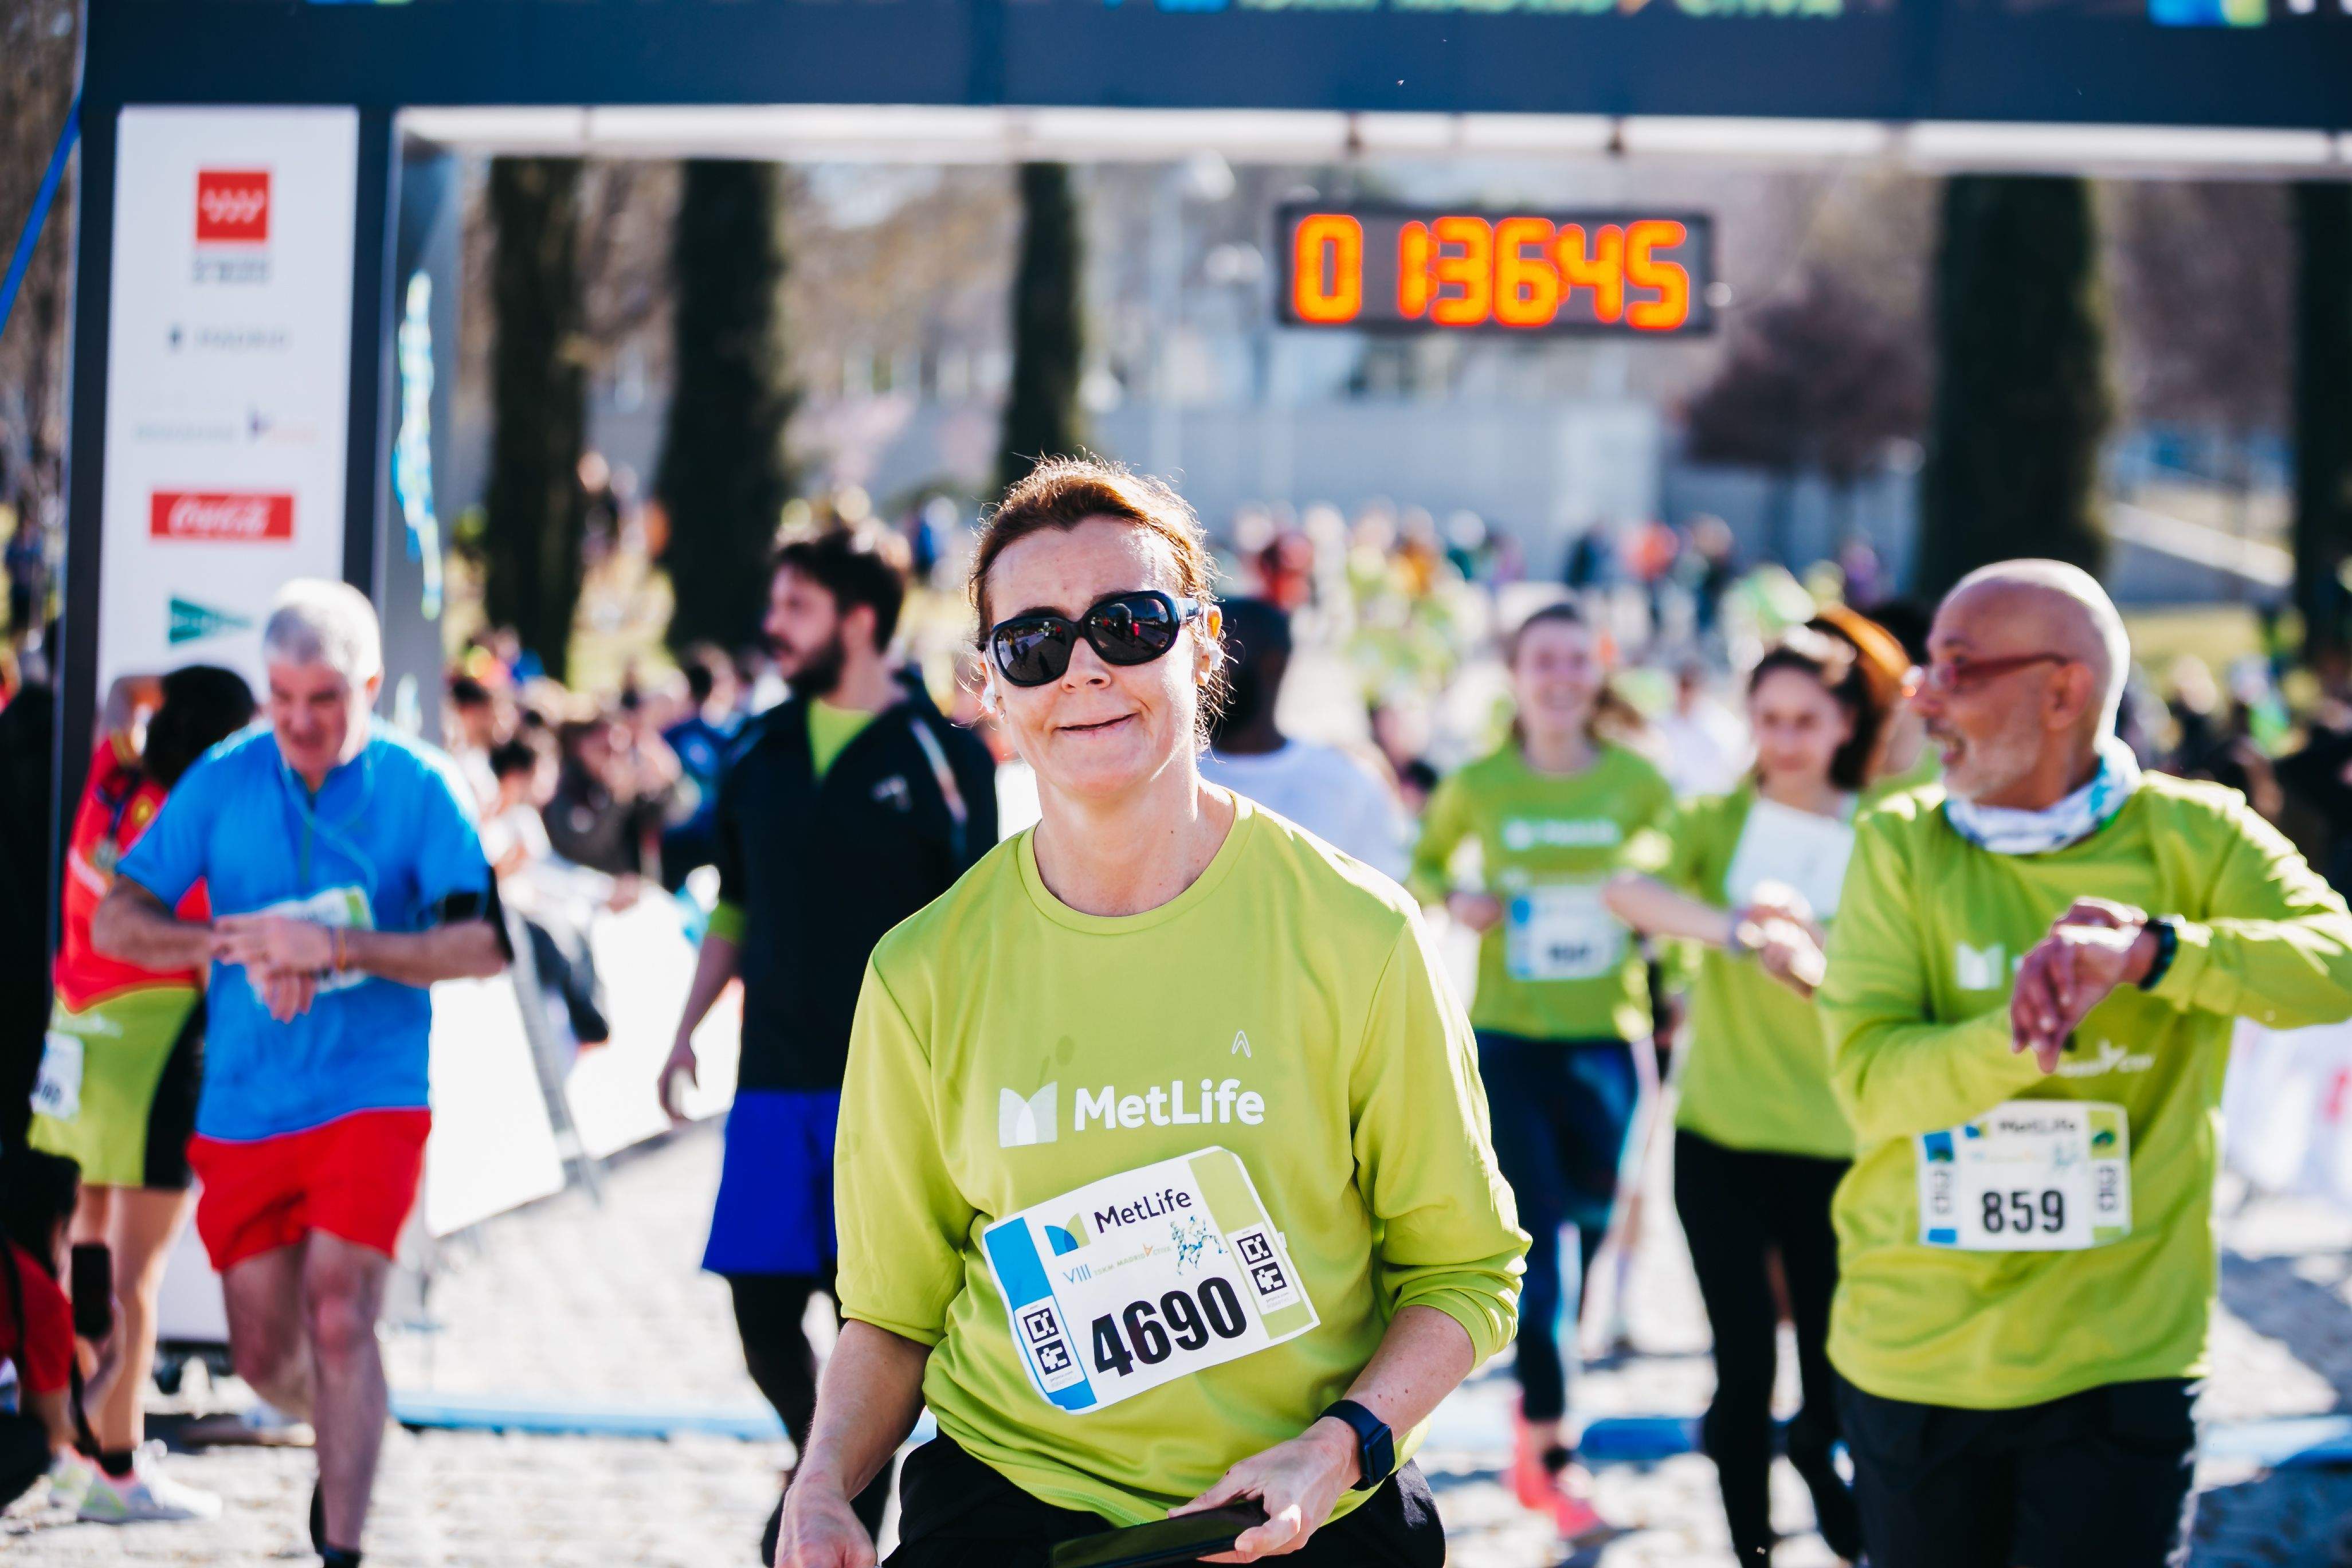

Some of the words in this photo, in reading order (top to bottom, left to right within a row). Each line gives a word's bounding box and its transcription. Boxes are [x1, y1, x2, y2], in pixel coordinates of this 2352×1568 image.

[1293, 213, 1363, 324] 0
[1075, 1079, 1265, 1131] MetLife
[1093, 1189, 1192, 1234] MetLife
[1982, 1190, 2065, 1233] 859
[1063, 1263, 1091, 1284] VIII
[1117, 1253, 1146, 1267] MADRID
[1092, 1277, 1247, 1377] 4690
